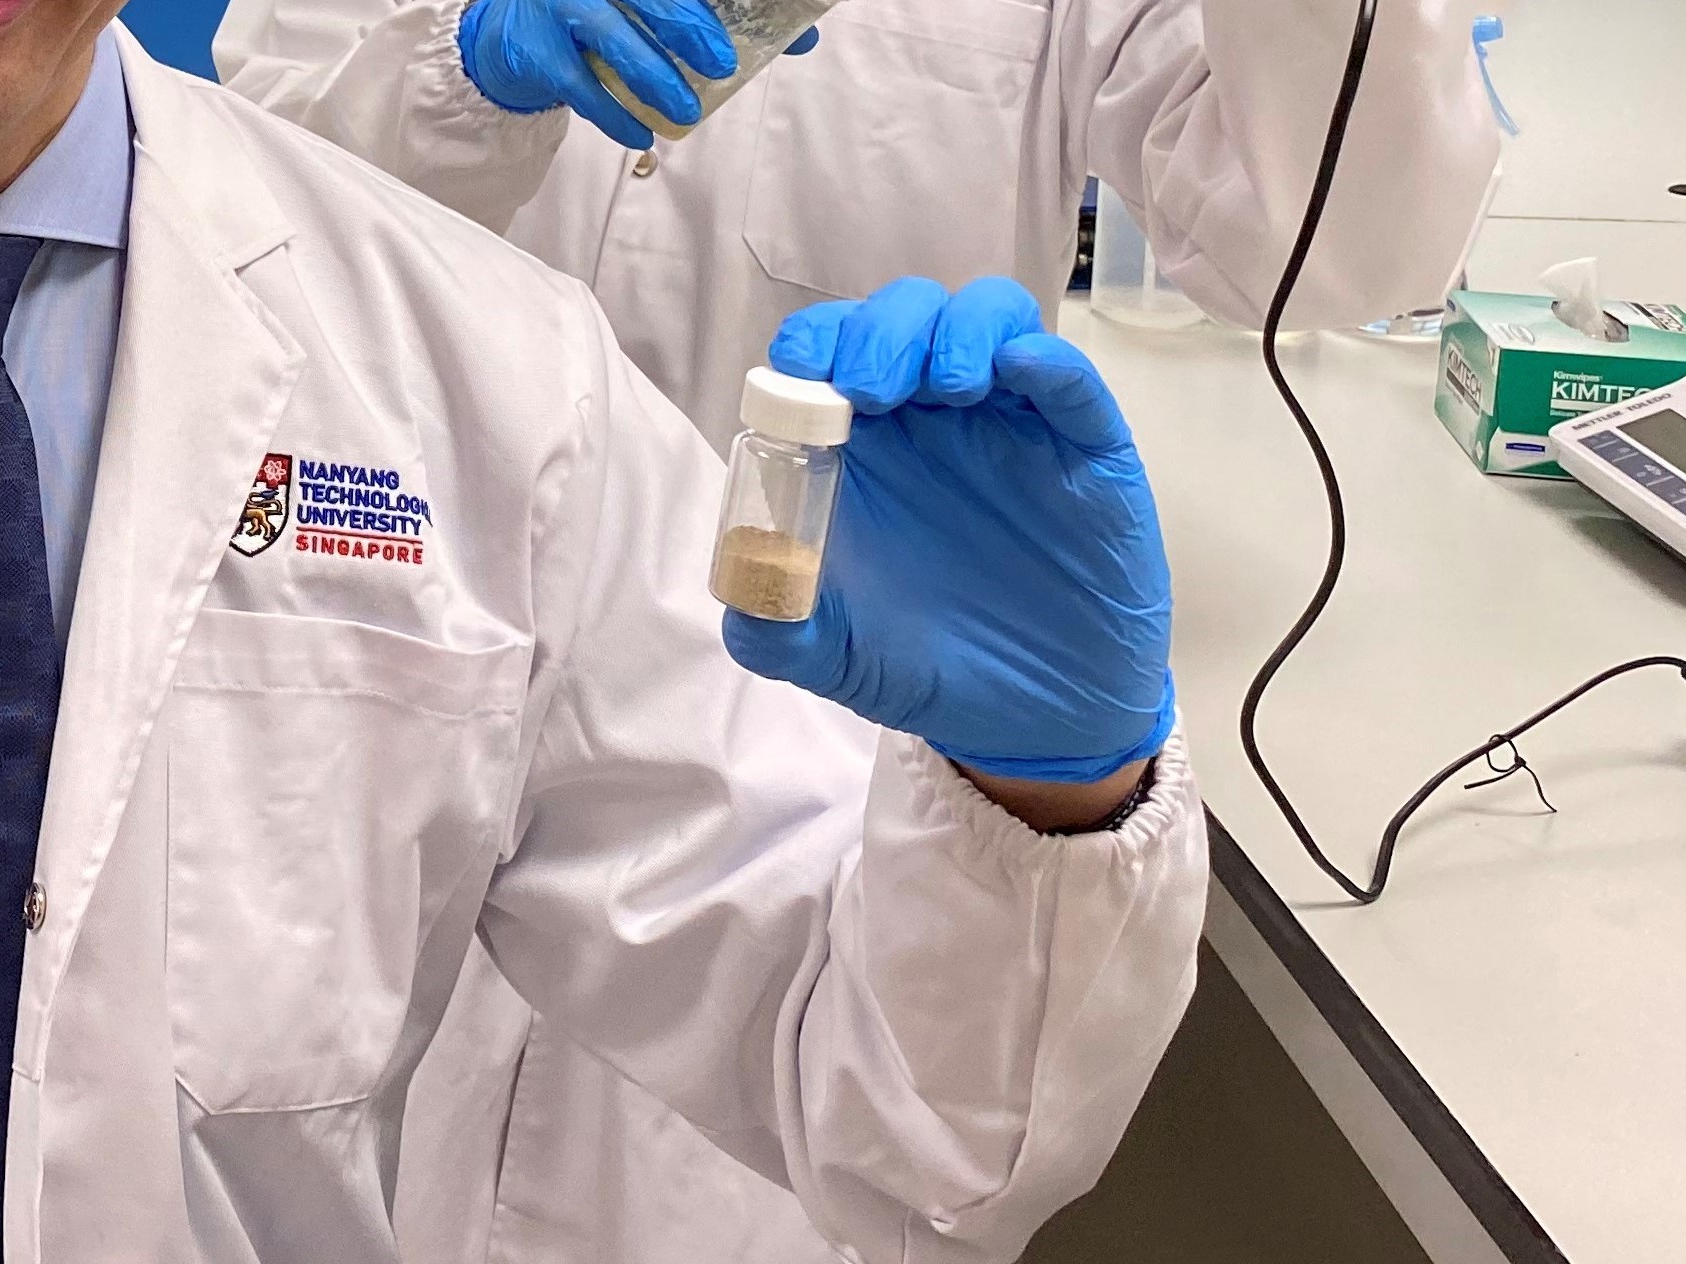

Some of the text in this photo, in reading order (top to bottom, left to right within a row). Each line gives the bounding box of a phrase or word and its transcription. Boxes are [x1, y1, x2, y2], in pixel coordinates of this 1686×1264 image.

[1571, 410, 1623, 431] METTLER
[1625, 393, 1673, 412] TOLEDO
[299, 459, 400, 490] NANYANG
[297, 503, 421, 536] UNIVERSITY
[296, 535, 423, 565] SINGAPORE
